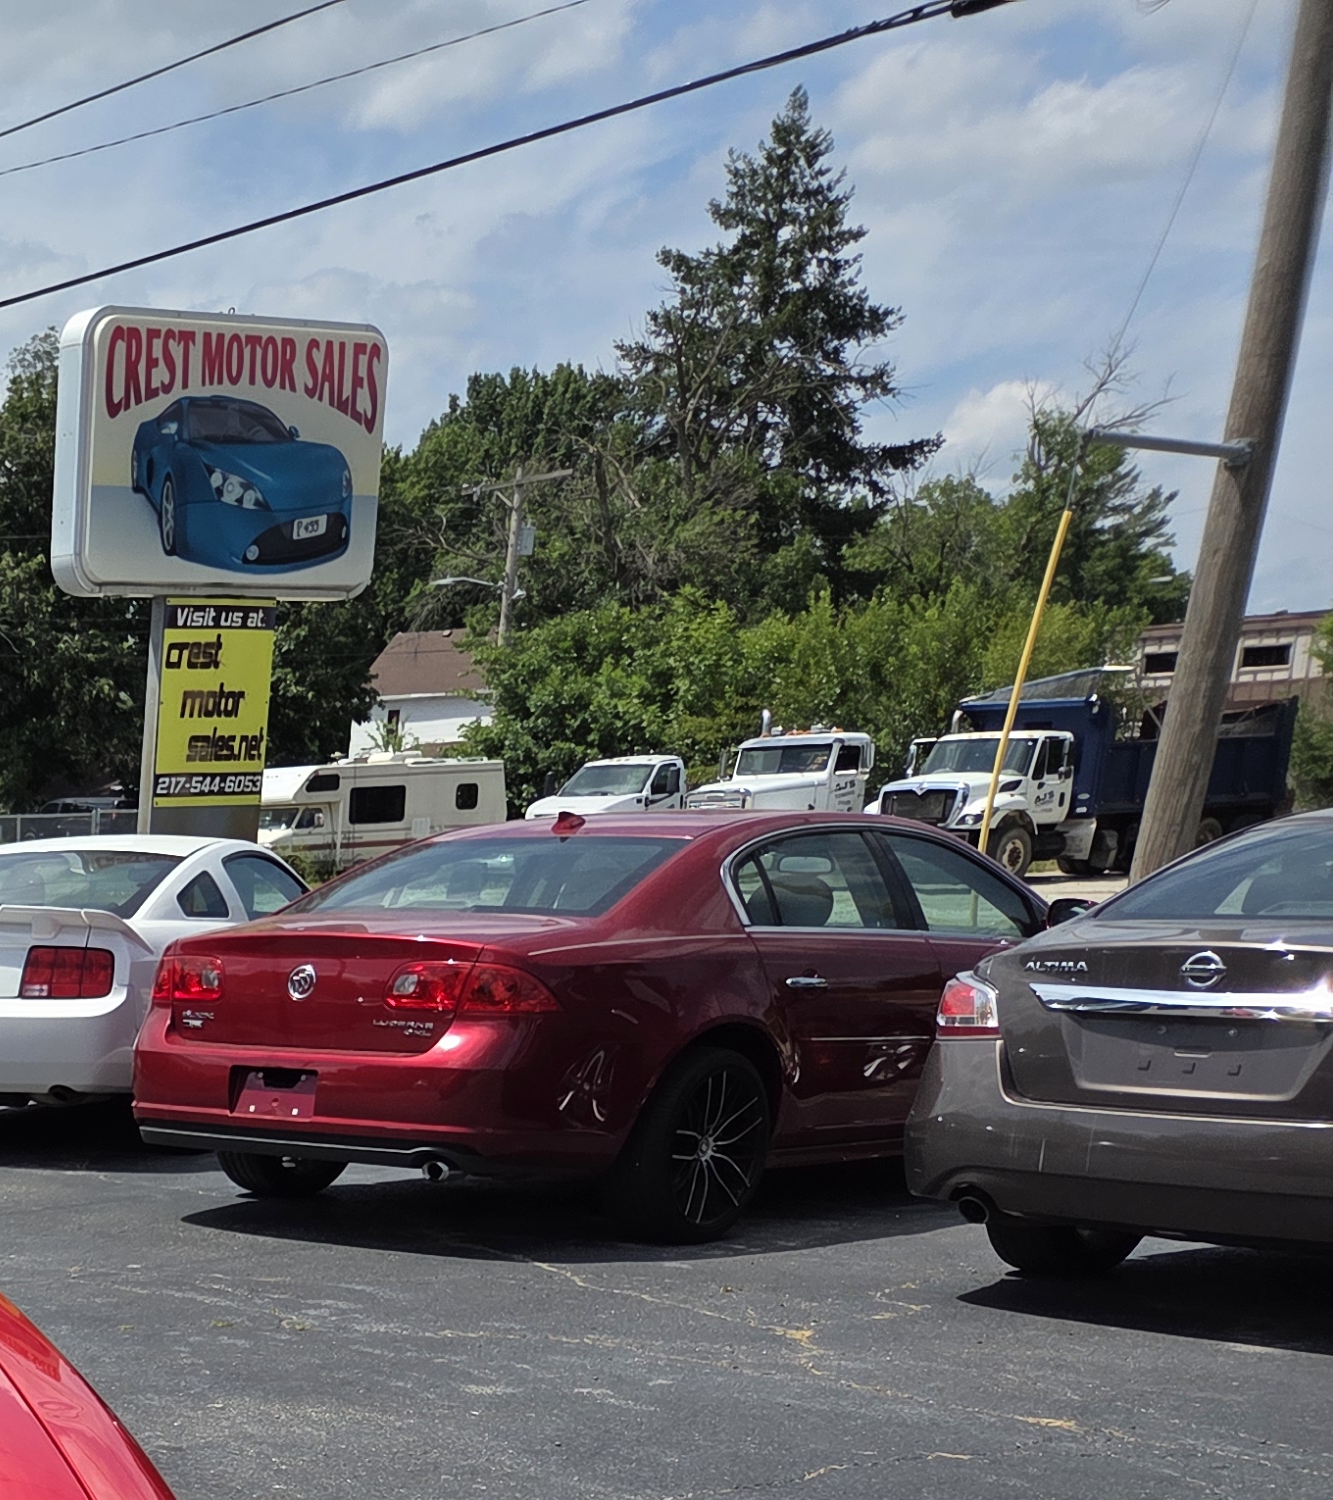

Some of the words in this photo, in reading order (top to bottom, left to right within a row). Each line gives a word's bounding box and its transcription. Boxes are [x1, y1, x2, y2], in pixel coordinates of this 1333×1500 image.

[104, 325, 196, 419] CREST
[201, 331, 297, 393] MOTOR
[304, 338, 381, 434] SALES
[177, 607, 216, 627] Visit
[220, 611, 244, 627] us
[165, 633, 222, 670] crest
[179, 682, 245, 719] motor
[186, 726, 264, 763] sales.net
[156, 775, 261, 794] 217-544-6053
[1024, 961, 1088, 971] ALTIMA
